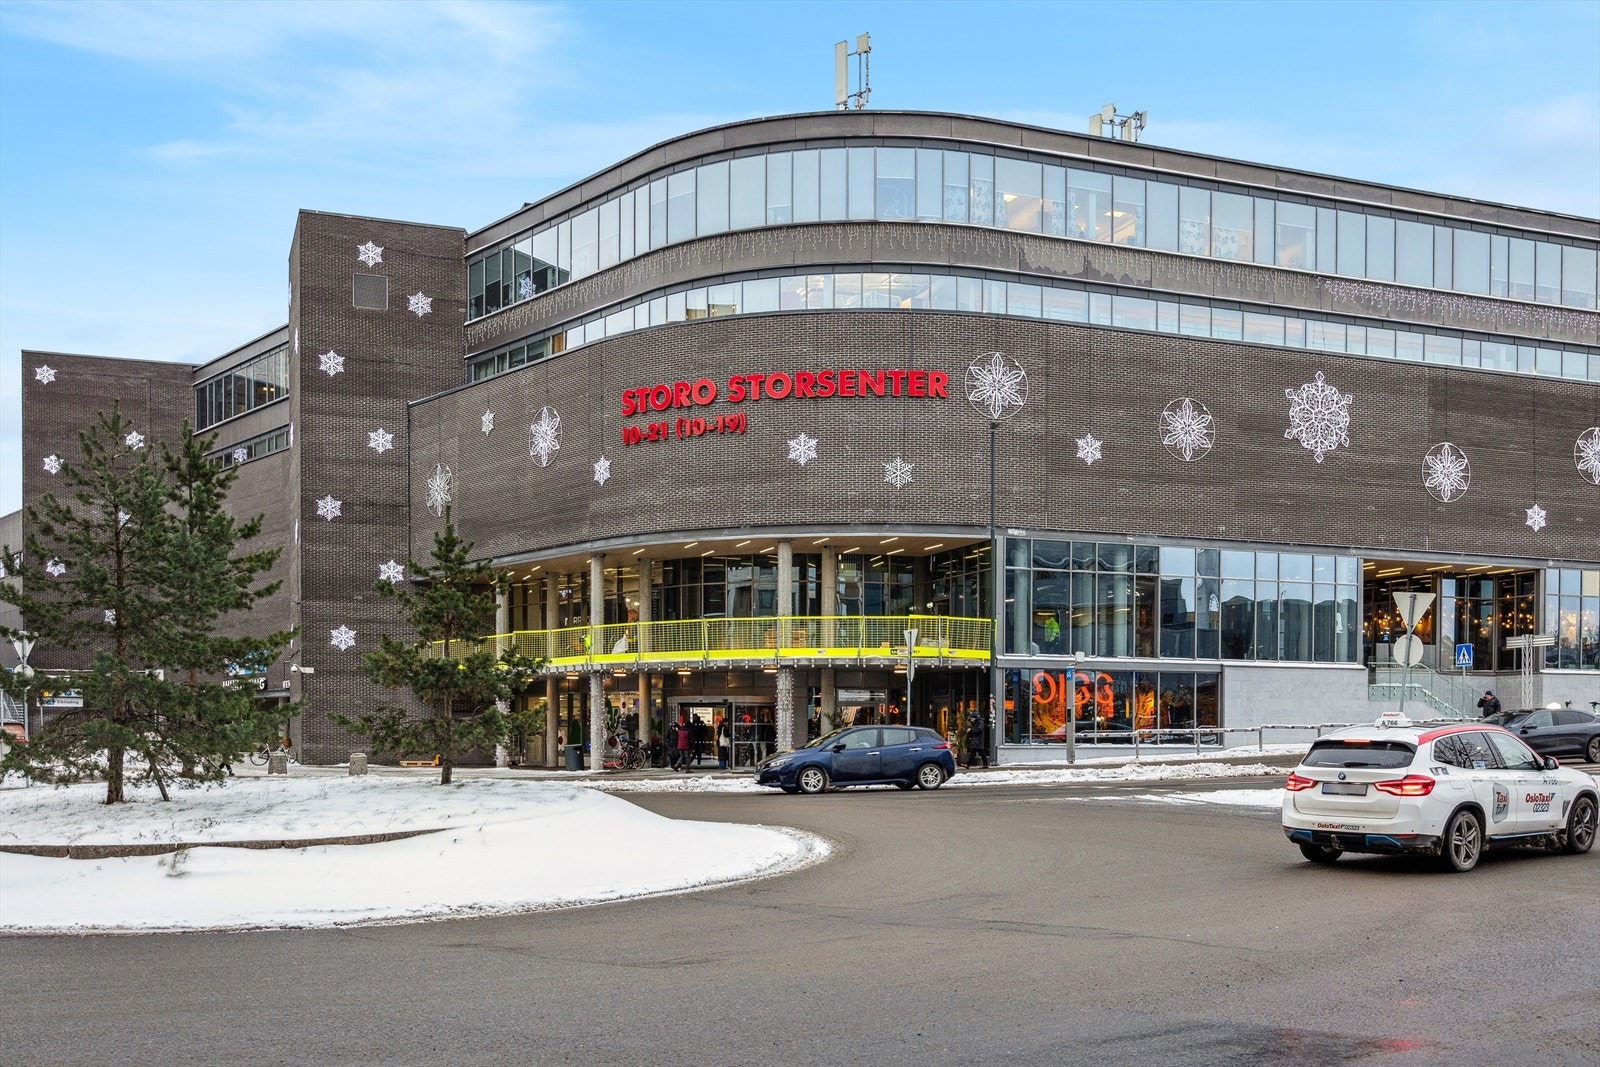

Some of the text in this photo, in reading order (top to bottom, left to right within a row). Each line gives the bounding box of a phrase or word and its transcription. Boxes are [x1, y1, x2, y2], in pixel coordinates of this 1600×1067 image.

[621, 369, 948, 416] STORO STORSENTER
[622, 412, 747, 445] 10-21 (10-19)
[1496, 791, 1508, 802] Taxi
[1525, 792, 1551, 803] OsloTaxi
[1533, 803, 1550, 813] 02323
